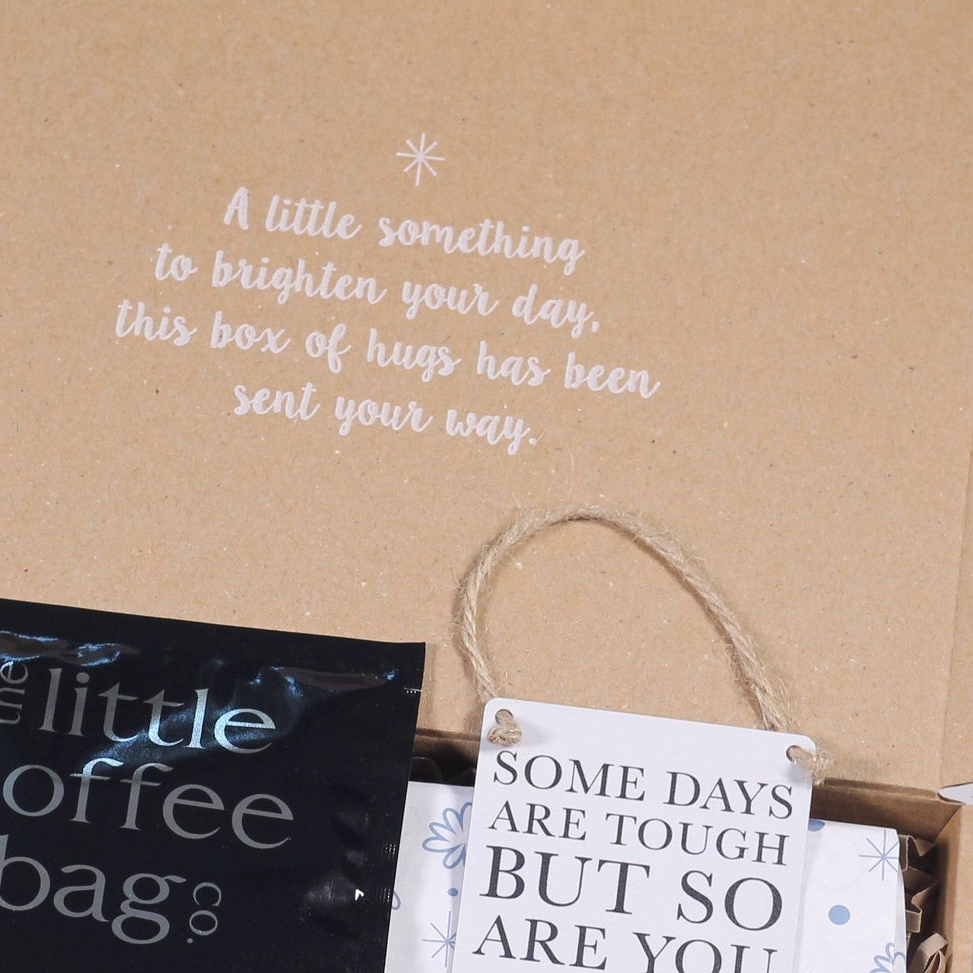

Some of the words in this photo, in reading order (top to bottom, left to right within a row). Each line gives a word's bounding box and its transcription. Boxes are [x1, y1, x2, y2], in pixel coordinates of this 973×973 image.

[223, 186, 249, 231] A
[265, 194, 362, 241] little
[378, 216, 585, 275] something
[155, 243, 198, 281] to
[212, 250, 387, 305] brighten
[402, 280, 499, 320] your
[511, 284, 601, 340] day,
[115, 299, 198, 347] this
[211, 311, 291, 354] box
[305, 323, 352, 373] of
[366, 329, 461, 382] hugs
[477, 341, 551, 388] has
[564, 351, 661, 399] been
[234, 381, 321, 421] sent
[334, 395, 433, 436] your
[446, 407, 538, 455] way.
[39, 667, 276, 755] little
[492, 750, 645, 802] SOME
[664, 771, 793, 820] DAYS
[488, 800, 587, 841] ARE
[605, 812, 790, 867] TOUGH
[479, 845, 651, 915] BUT
[677, 869, 783, 931] SO
[472, 914, 608, 971] ARE
